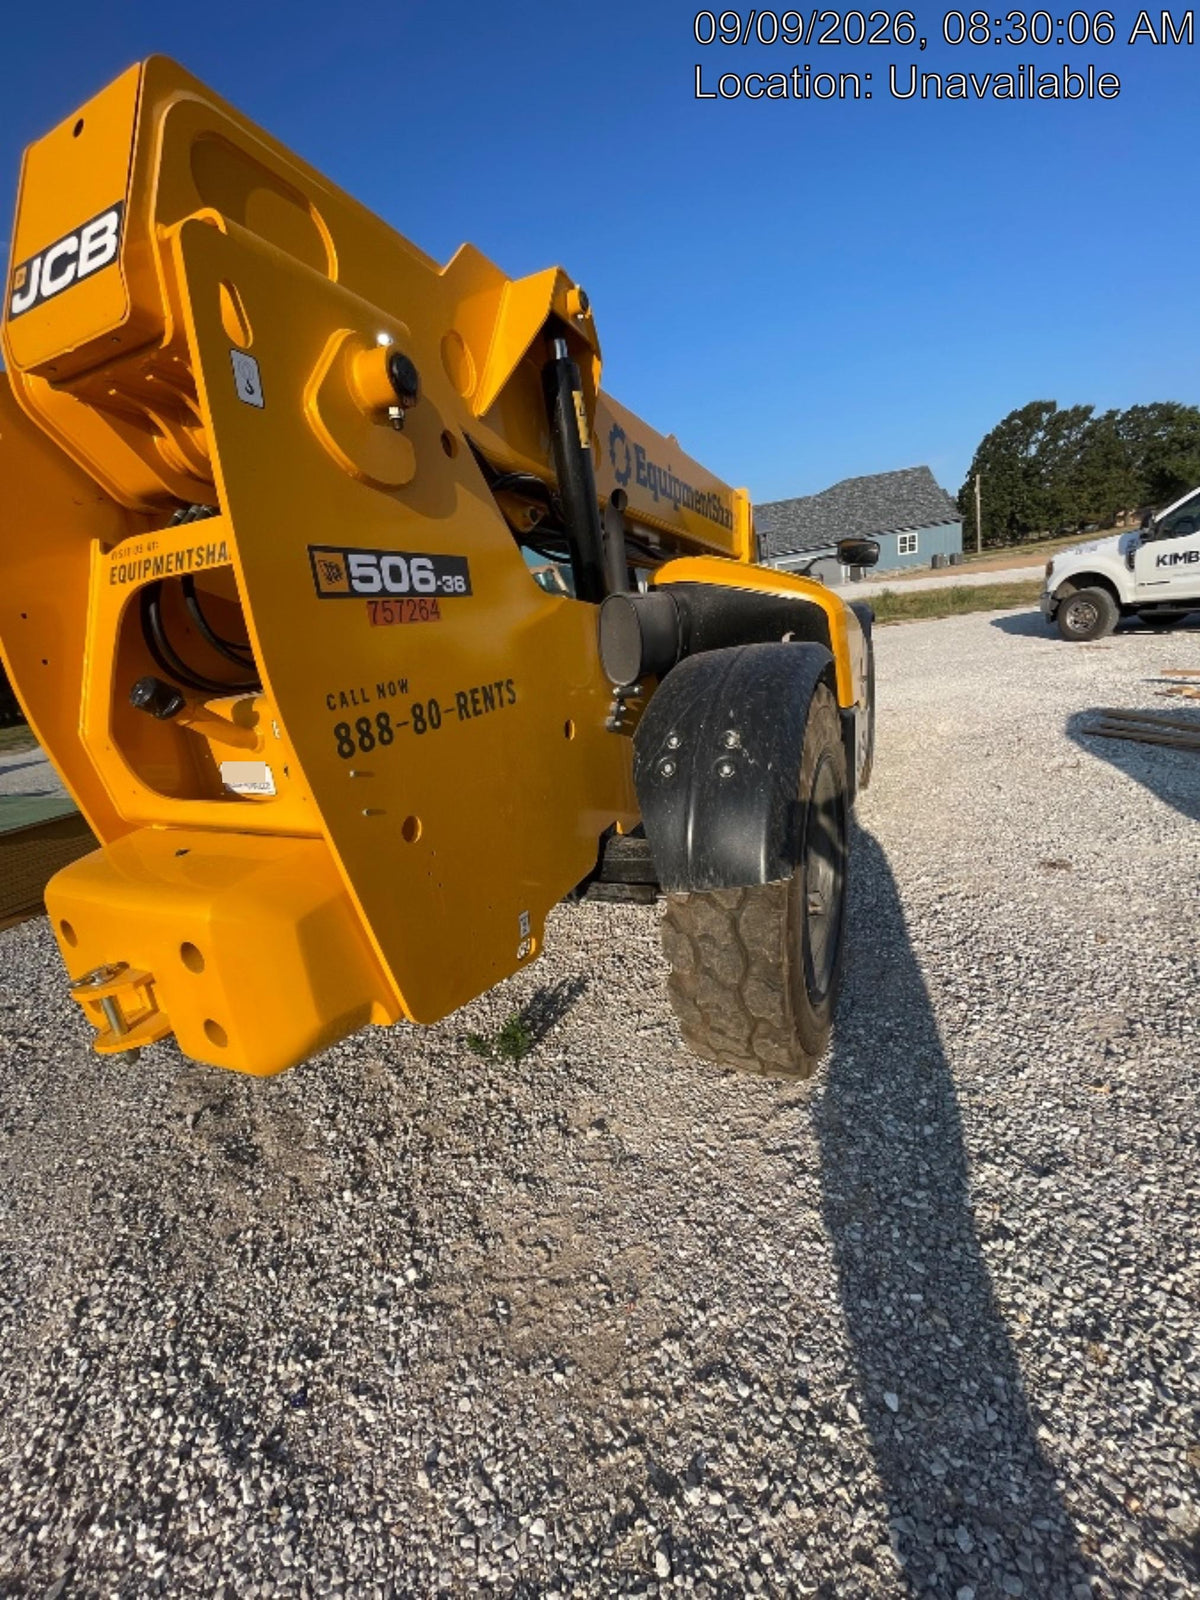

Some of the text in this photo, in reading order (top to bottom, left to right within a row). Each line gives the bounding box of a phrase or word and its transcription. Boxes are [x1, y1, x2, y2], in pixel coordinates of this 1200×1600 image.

[11, 210, 119, 314] JCB
[367, 598, 441, 625] 757264
[326, 678, 409, 711] CALL NOW
[333, 678, 517, 760] 888-80-RENTS
